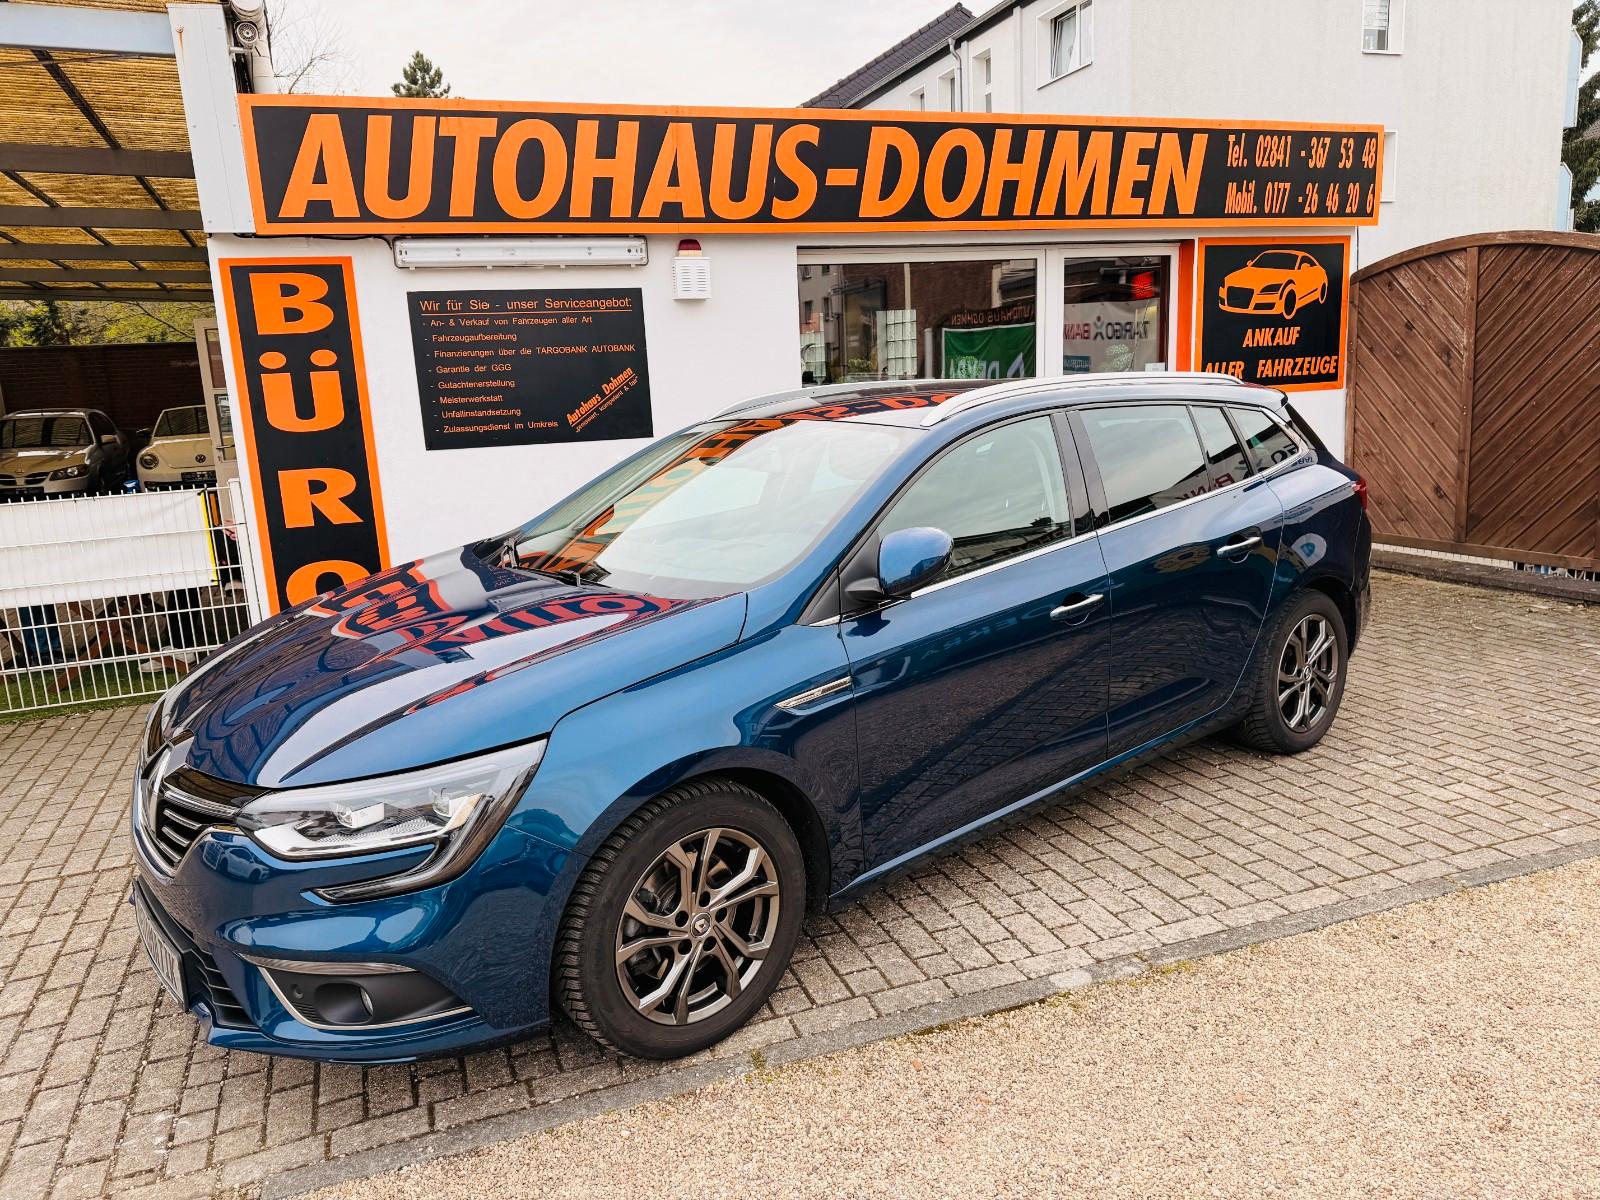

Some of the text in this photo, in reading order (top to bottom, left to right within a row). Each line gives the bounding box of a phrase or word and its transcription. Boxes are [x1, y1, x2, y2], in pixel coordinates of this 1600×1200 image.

[1226, 132, 1248, 168] Tel.
[1254, 134, 1293, 168] 02841
[1338, 137, 1355, 169] 53
[1361, 137, 1377, 169] 48
[277, 112, 1209, 221] AUTOHAUS-DOHMEN
[1224, 180, 1258, 214] Mobil.
[1263, 181, 1292, 214] 0177
[1325, 183, 1340, 214] 46
[1345, 182, 1361, 214] 20
[1366, 183, 1375, 214] 6
[419, 300, 440, 311] Wir
[446, 300, 463, 311] für
[506, 299, 539, 310] unser
[544, 297, 632, 310] Serviceangebot:
[448, 319, 456, 327] &
[459, 317, 491, 327] Verkauf
[512, 317, 558, 326] Fahrzeugen
[561, 315, 578, 325] aller
[581, 315, 593, 324] Art
[431, 332, 517, 343] Fahrzeugaufbereitung
[1242, 326, 1301, 348] ANKAUF
[434, 343, 636, 359] Finanzierungen über die TARGOBANK AUTOBANK
[435, 363, 512, 374] Garantie der GGG
[1256, 355, 1339, 379] FAHRZEUGE
[438, 379, 516, 390] Gutachtenerstellung
[439, 394, 504, 405] Meisterwerkstatt
[566, 367, 633, 425] Autohaus Dohmen
[441, 407, 522, 419] Unfallinstandsetzung
[443, 420, 559, 434] Zulassungsdienst im Umkreis
